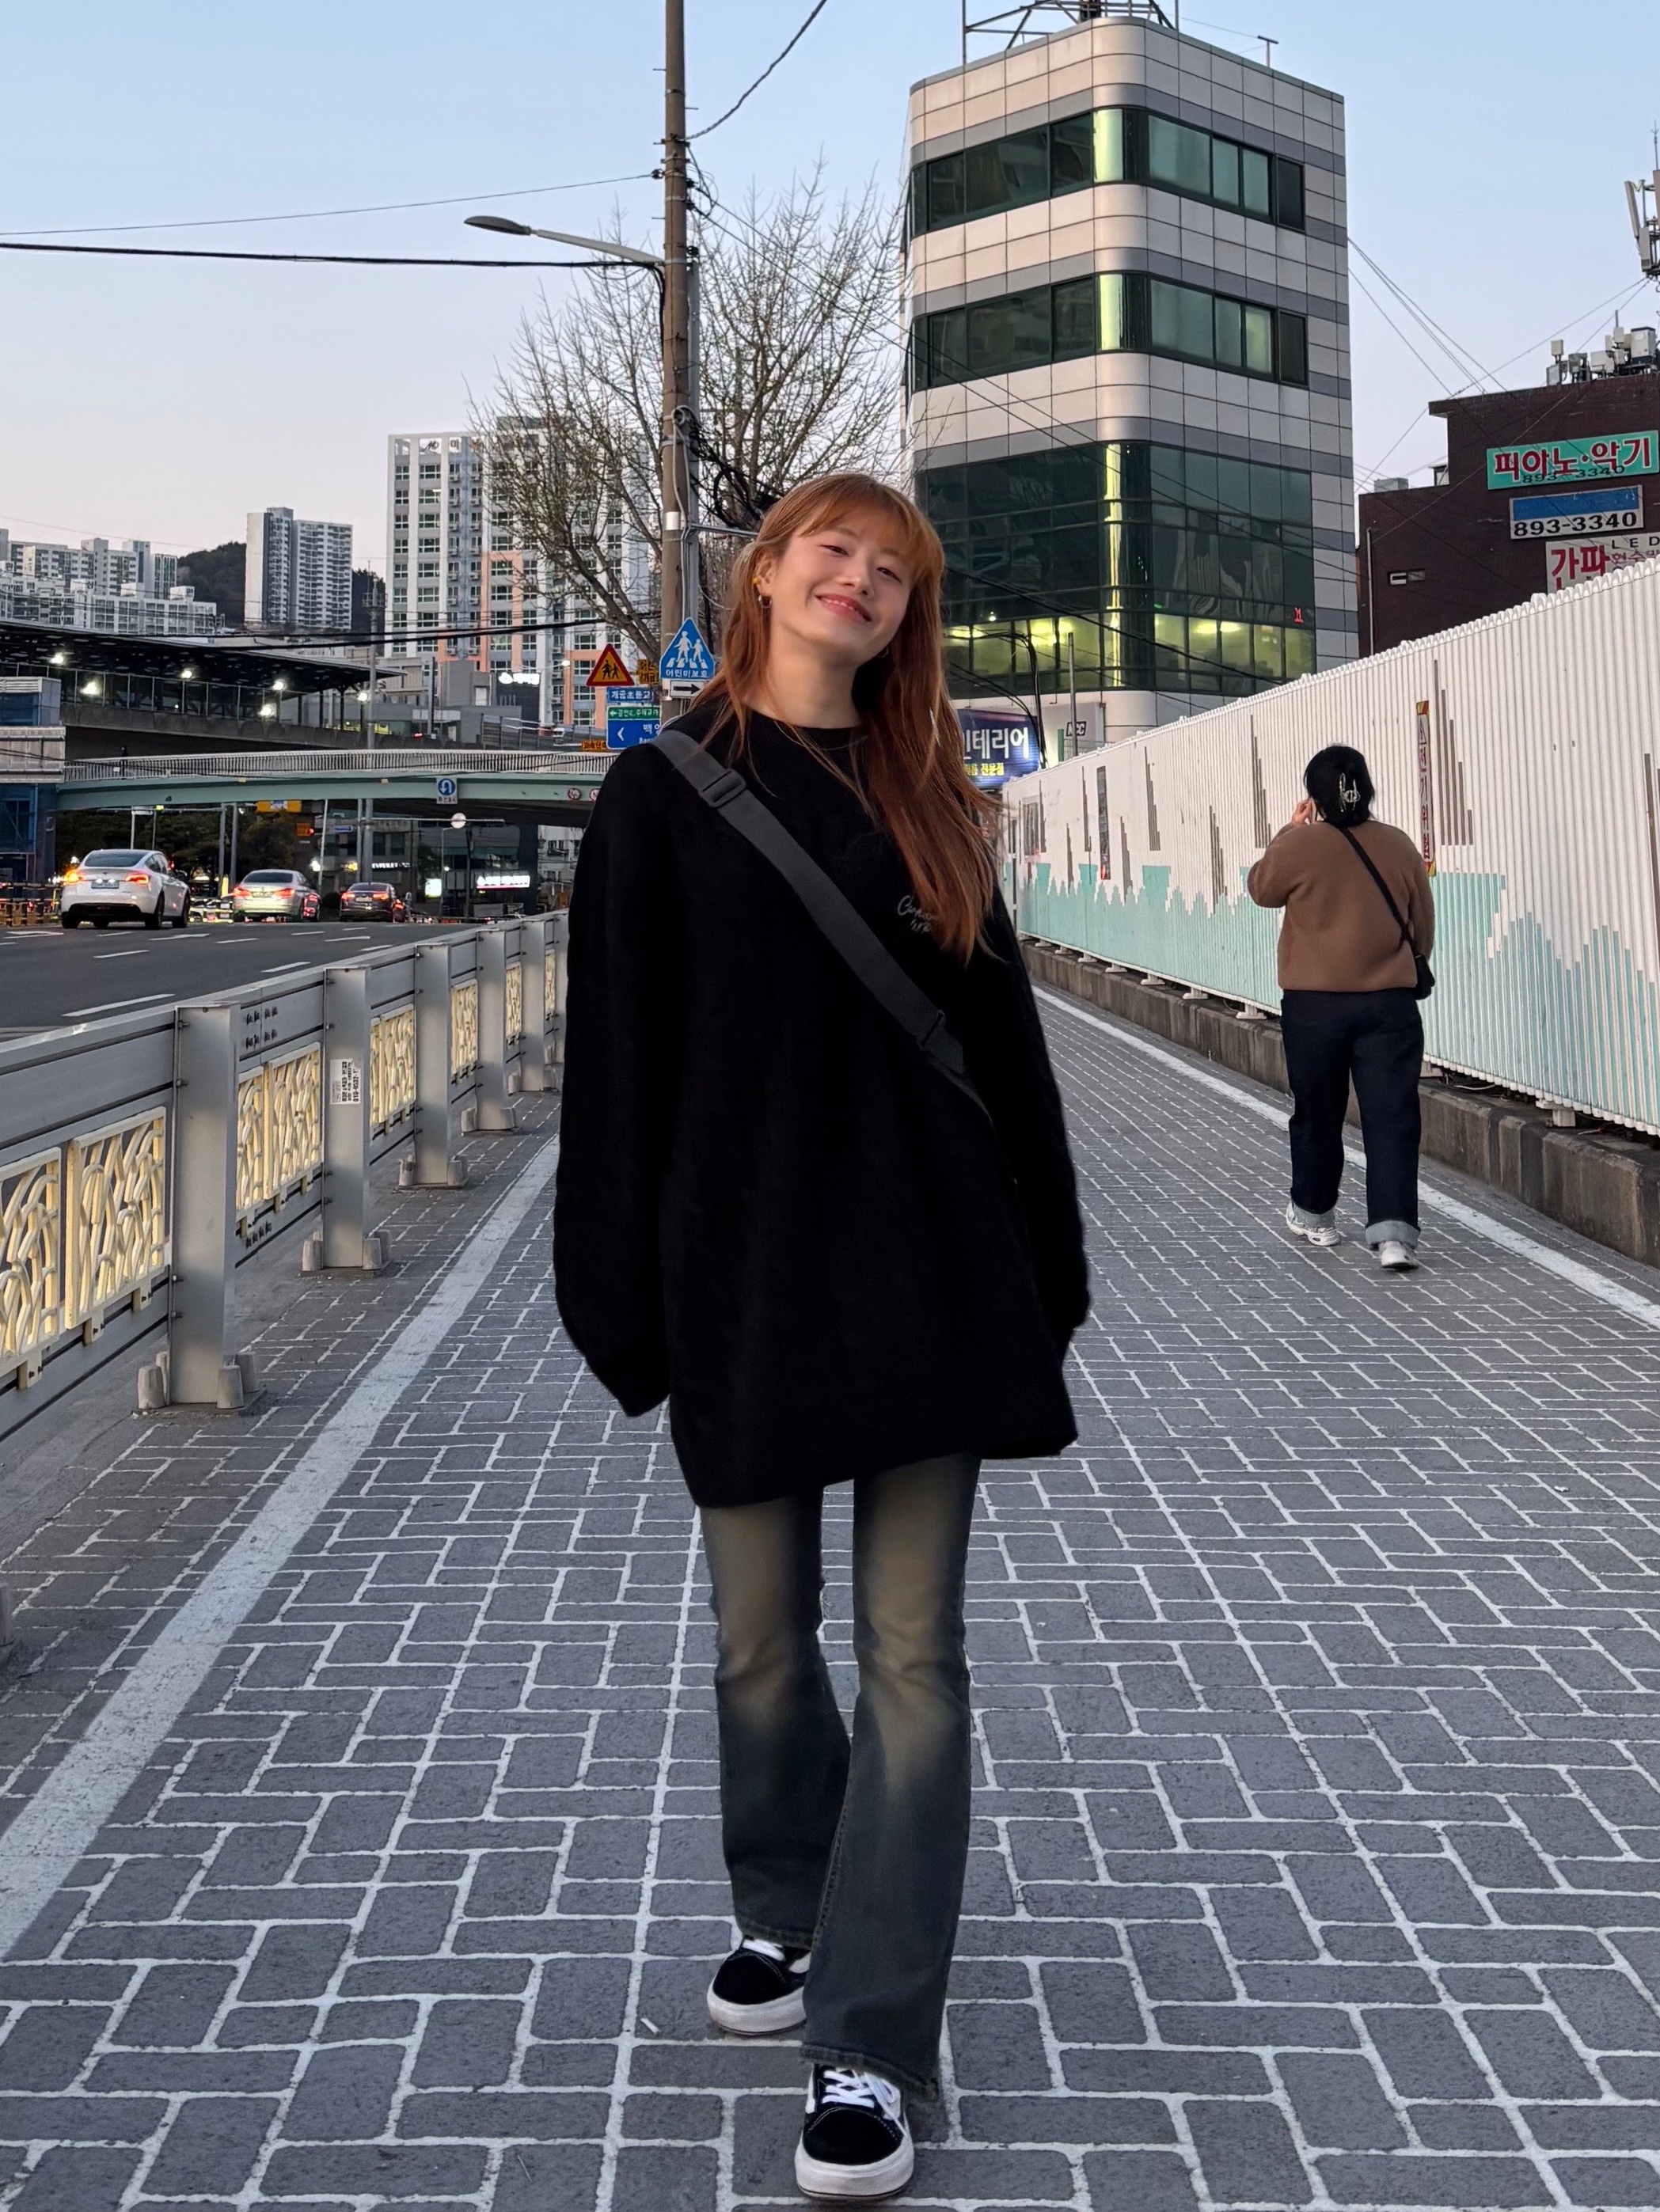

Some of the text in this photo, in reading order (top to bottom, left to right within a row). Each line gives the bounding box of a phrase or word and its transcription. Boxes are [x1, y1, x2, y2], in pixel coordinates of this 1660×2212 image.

[1514, 512, 1637, 537] 893-3340
[1612, 536, 1660, 549] LED
[666, 669, 709, 678] 어린이보호
